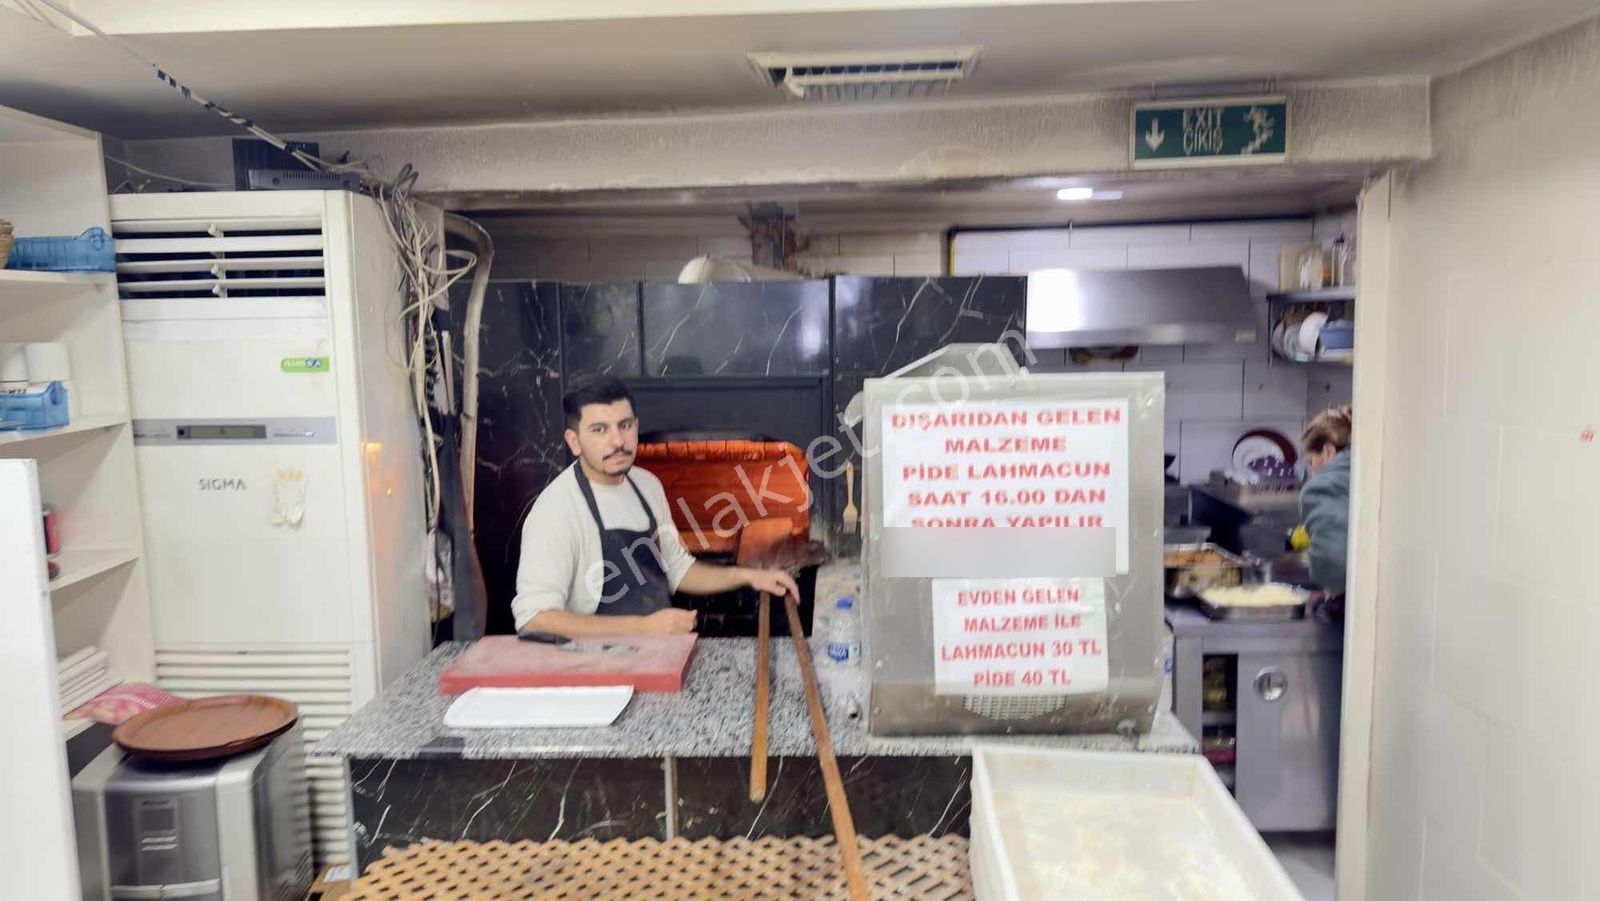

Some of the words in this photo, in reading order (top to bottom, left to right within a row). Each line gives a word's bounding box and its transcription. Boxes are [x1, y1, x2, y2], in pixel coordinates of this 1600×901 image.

[1182, 107, 1224, 131] EXIT
[891, 411, 1028, 430] DIŞARIDAN
[1036, 408, 1122, 425] GELEN
[945, 436, 1067, 454] MALZEME
[902, 461, 959, 480] PİDE
[967, 462, 1111, 479] LAHMACUN
[199, 478, 247, 491] SIGMA
[908, 491, 971, 506] SAAT
[981, 489, 1046, 505] 16.00
[1055, 488, 1106, 504] DAN
[957, 590, 1016, 606] EVDEN
[1022, 589, 1079, 604] GELEN
[964, 615, 1048, 632] MALZEME
[1054, 612, 1081, 629] İLE
[941, 642, 1045, 662] LAHMACUN
[1052, 640, 1074, 658] 30
[1079, 639, 1101, 657] TL
[973, 669, 1015, 687] PİDE
[1021, 671, 1043, 687] 40
[1048, 669, 1072, 686] TL
